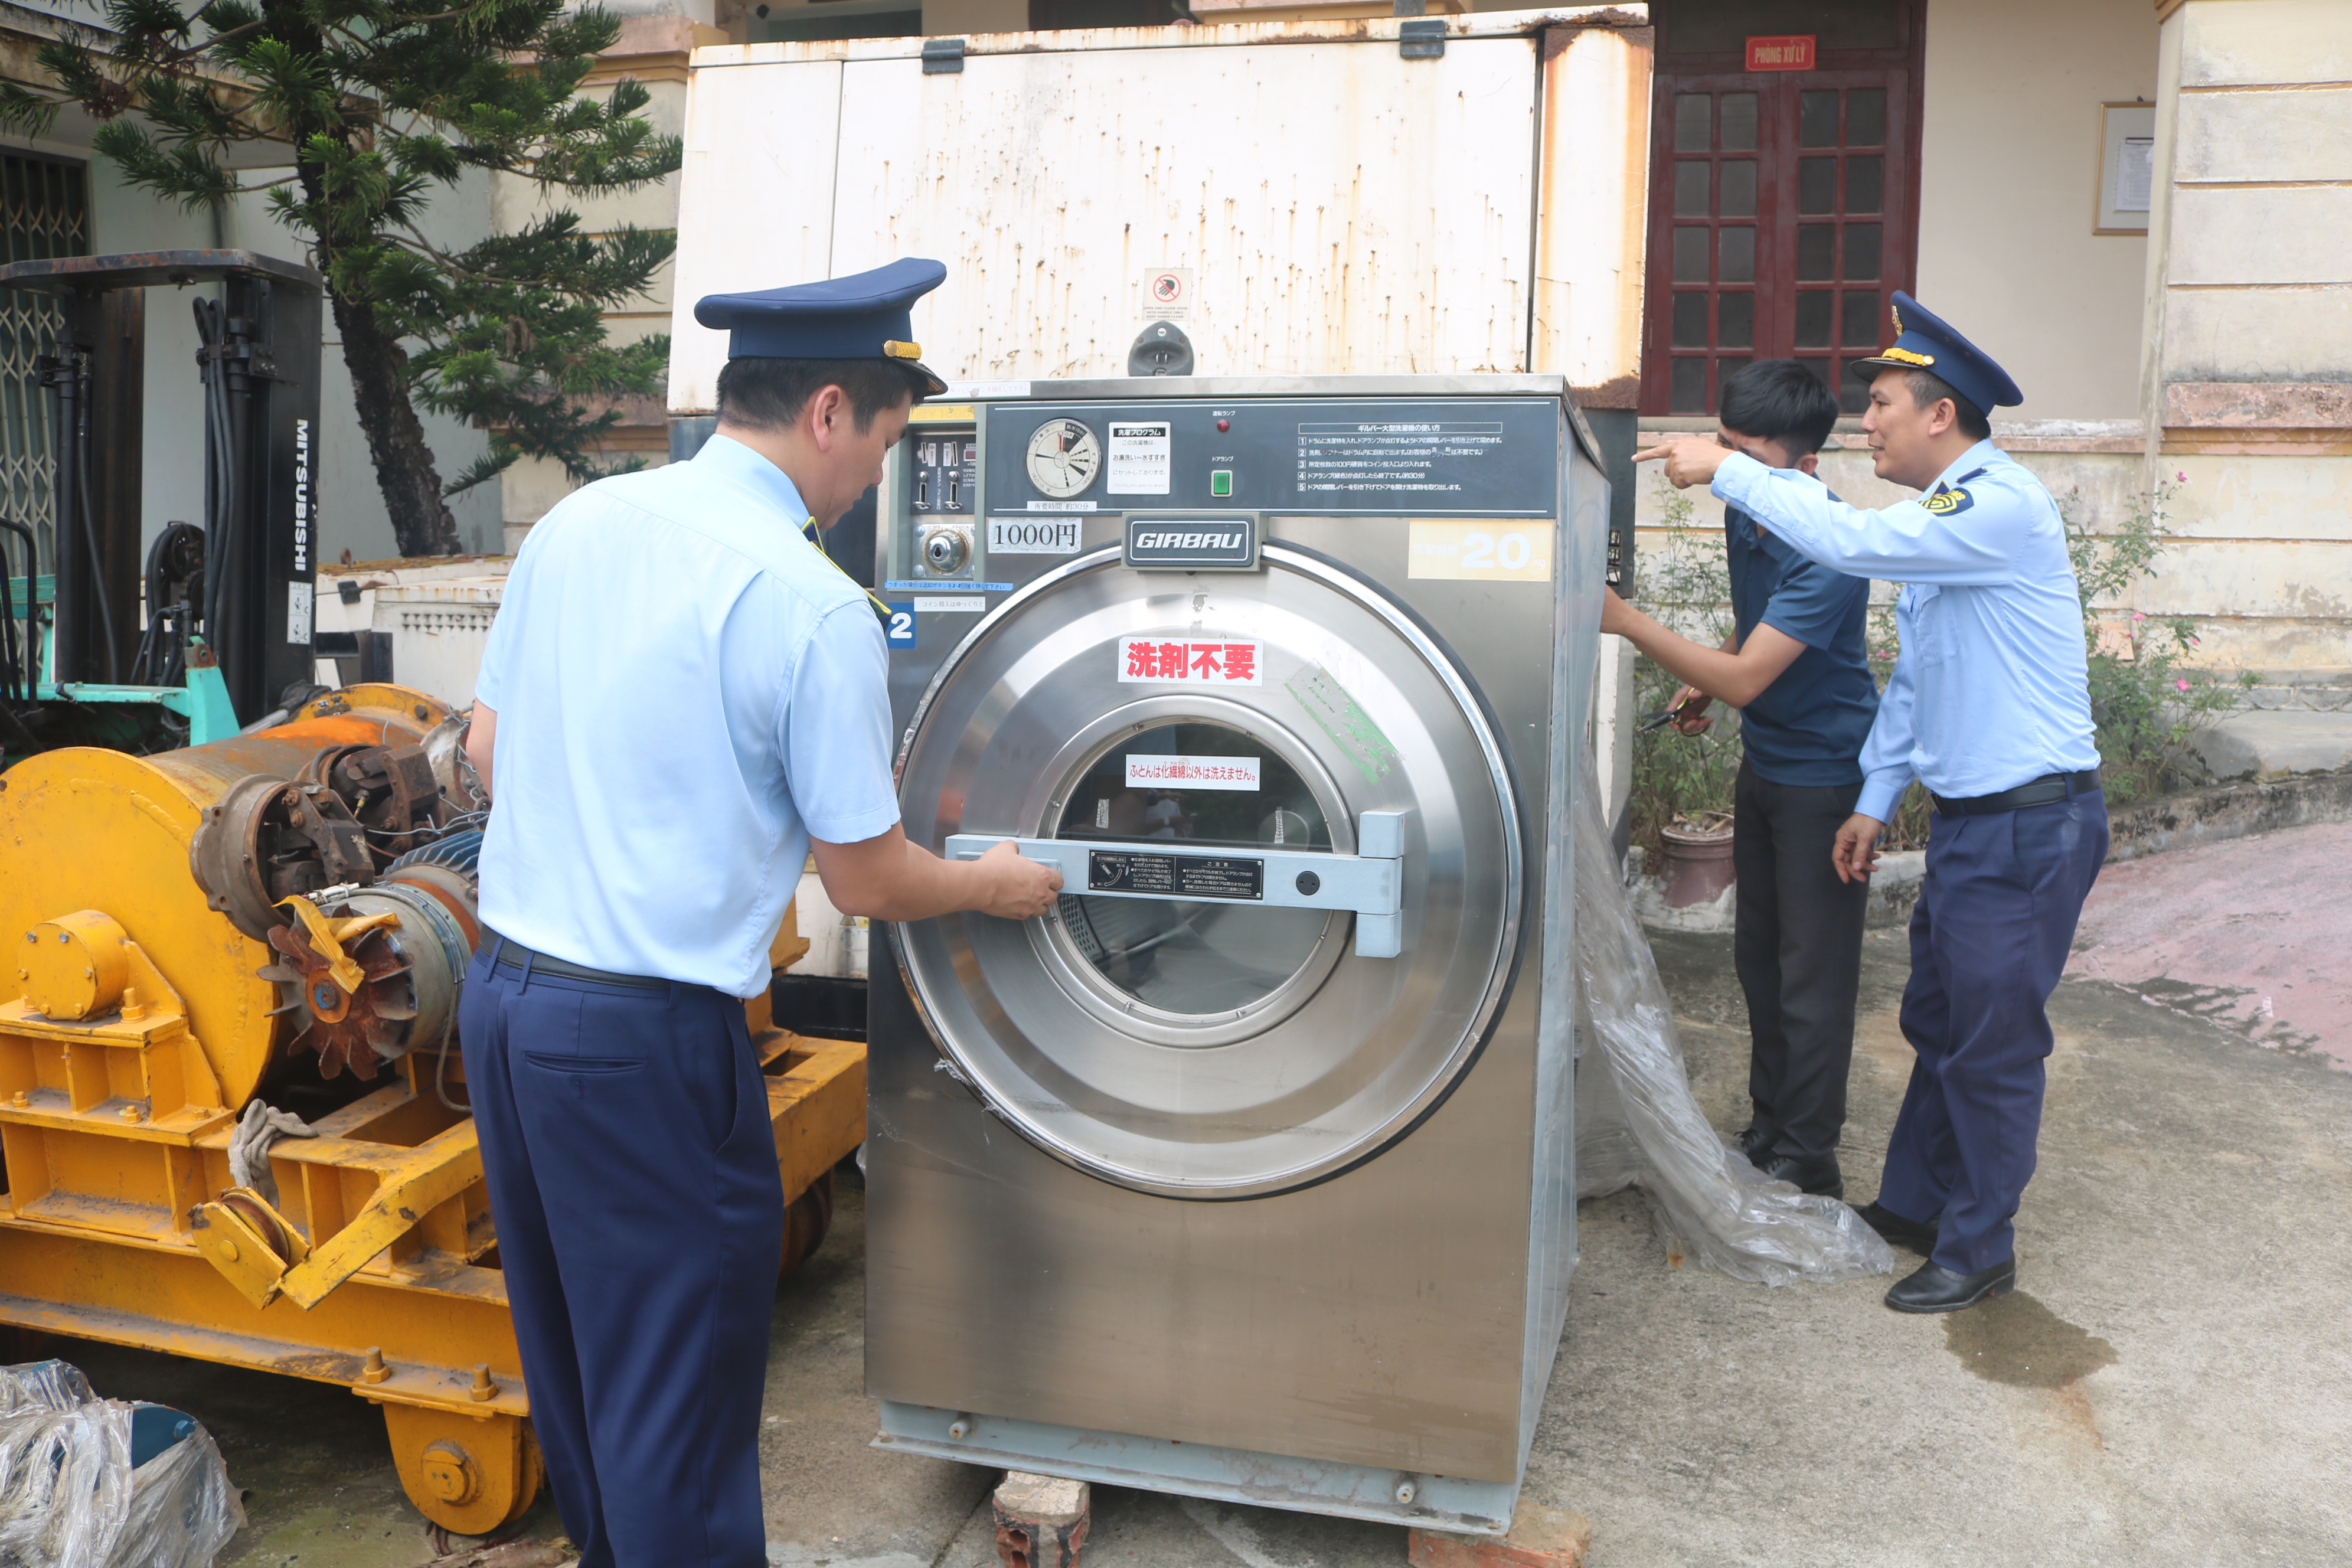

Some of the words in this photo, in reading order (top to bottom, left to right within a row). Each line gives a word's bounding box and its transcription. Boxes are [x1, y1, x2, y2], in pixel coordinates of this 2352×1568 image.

[1755, 43, 1782, 63] PHÒNG
[1783, 39, 1795, 63] XỬ
[1796, 43, 1805, 63] LÝ
[295, 419, 308, 571] MITSUBISHI
[1034, 502, 1062, 511] 所要時間
[1065, 502, 1089, 511] 約30分
[994, 523, 1076, 547] 1000円
[1136, 533, 1243, 549] GIRBAU
[1461, 533, 1531, 570] 20
[1533, 554, 1546, 570] kg
[890, 612, 913, 639] 2
[1127, 642, 1256, 681] 洗剤不要
